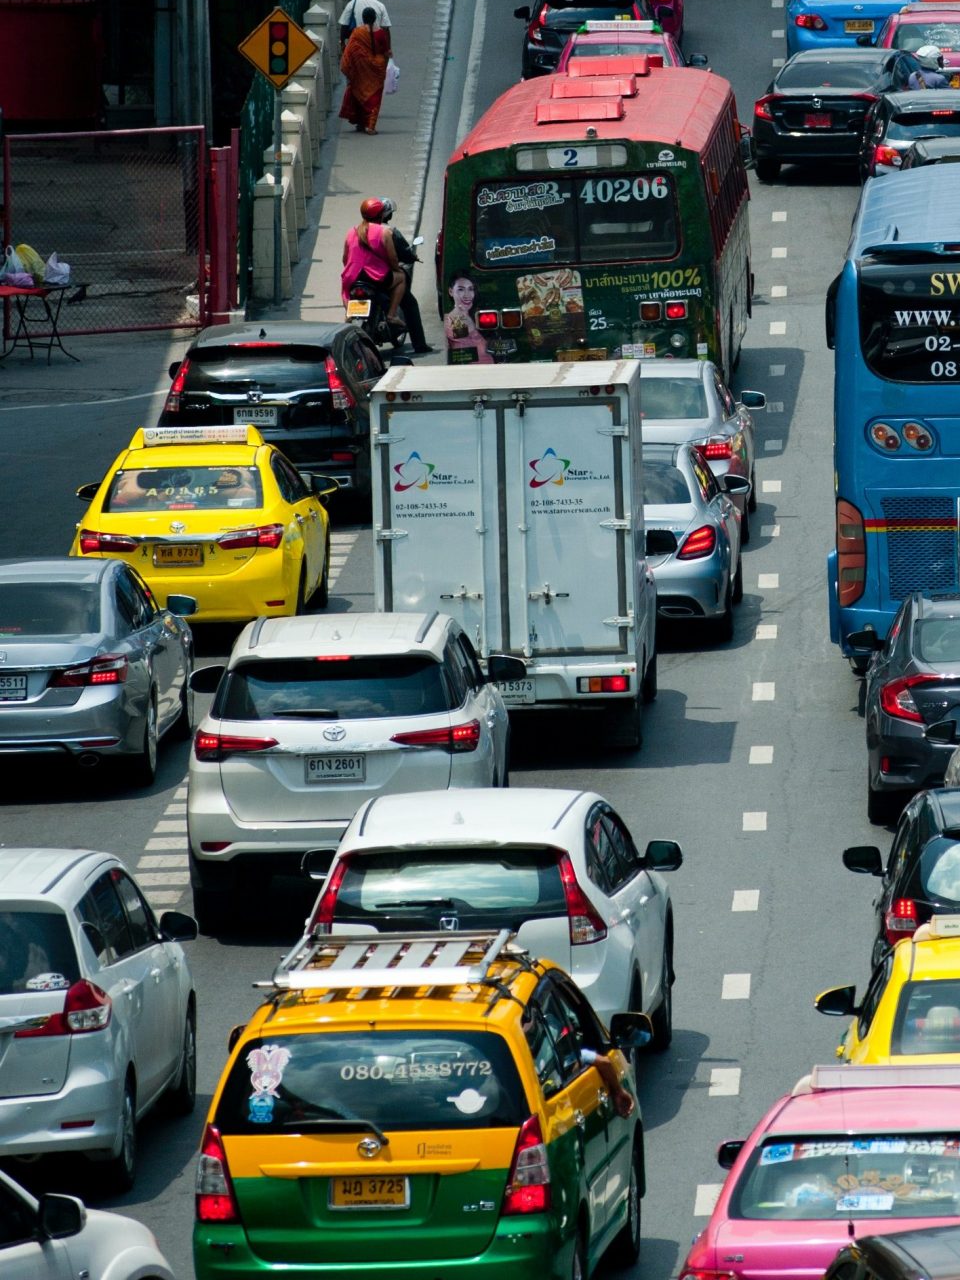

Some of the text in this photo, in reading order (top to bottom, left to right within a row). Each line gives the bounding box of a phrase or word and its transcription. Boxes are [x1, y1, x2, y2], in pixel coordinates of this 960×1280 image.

[563, 149, 578, 167] 2
[580, 176, 668, 205] 40206
[651, 267, 702, 289] 100%
[431, 472, 453, 480] Star
[508, 681, 533, 693] 5373
[335, 757, 362, 771] 2601
[368, 1178, 404, 1194] 3725
